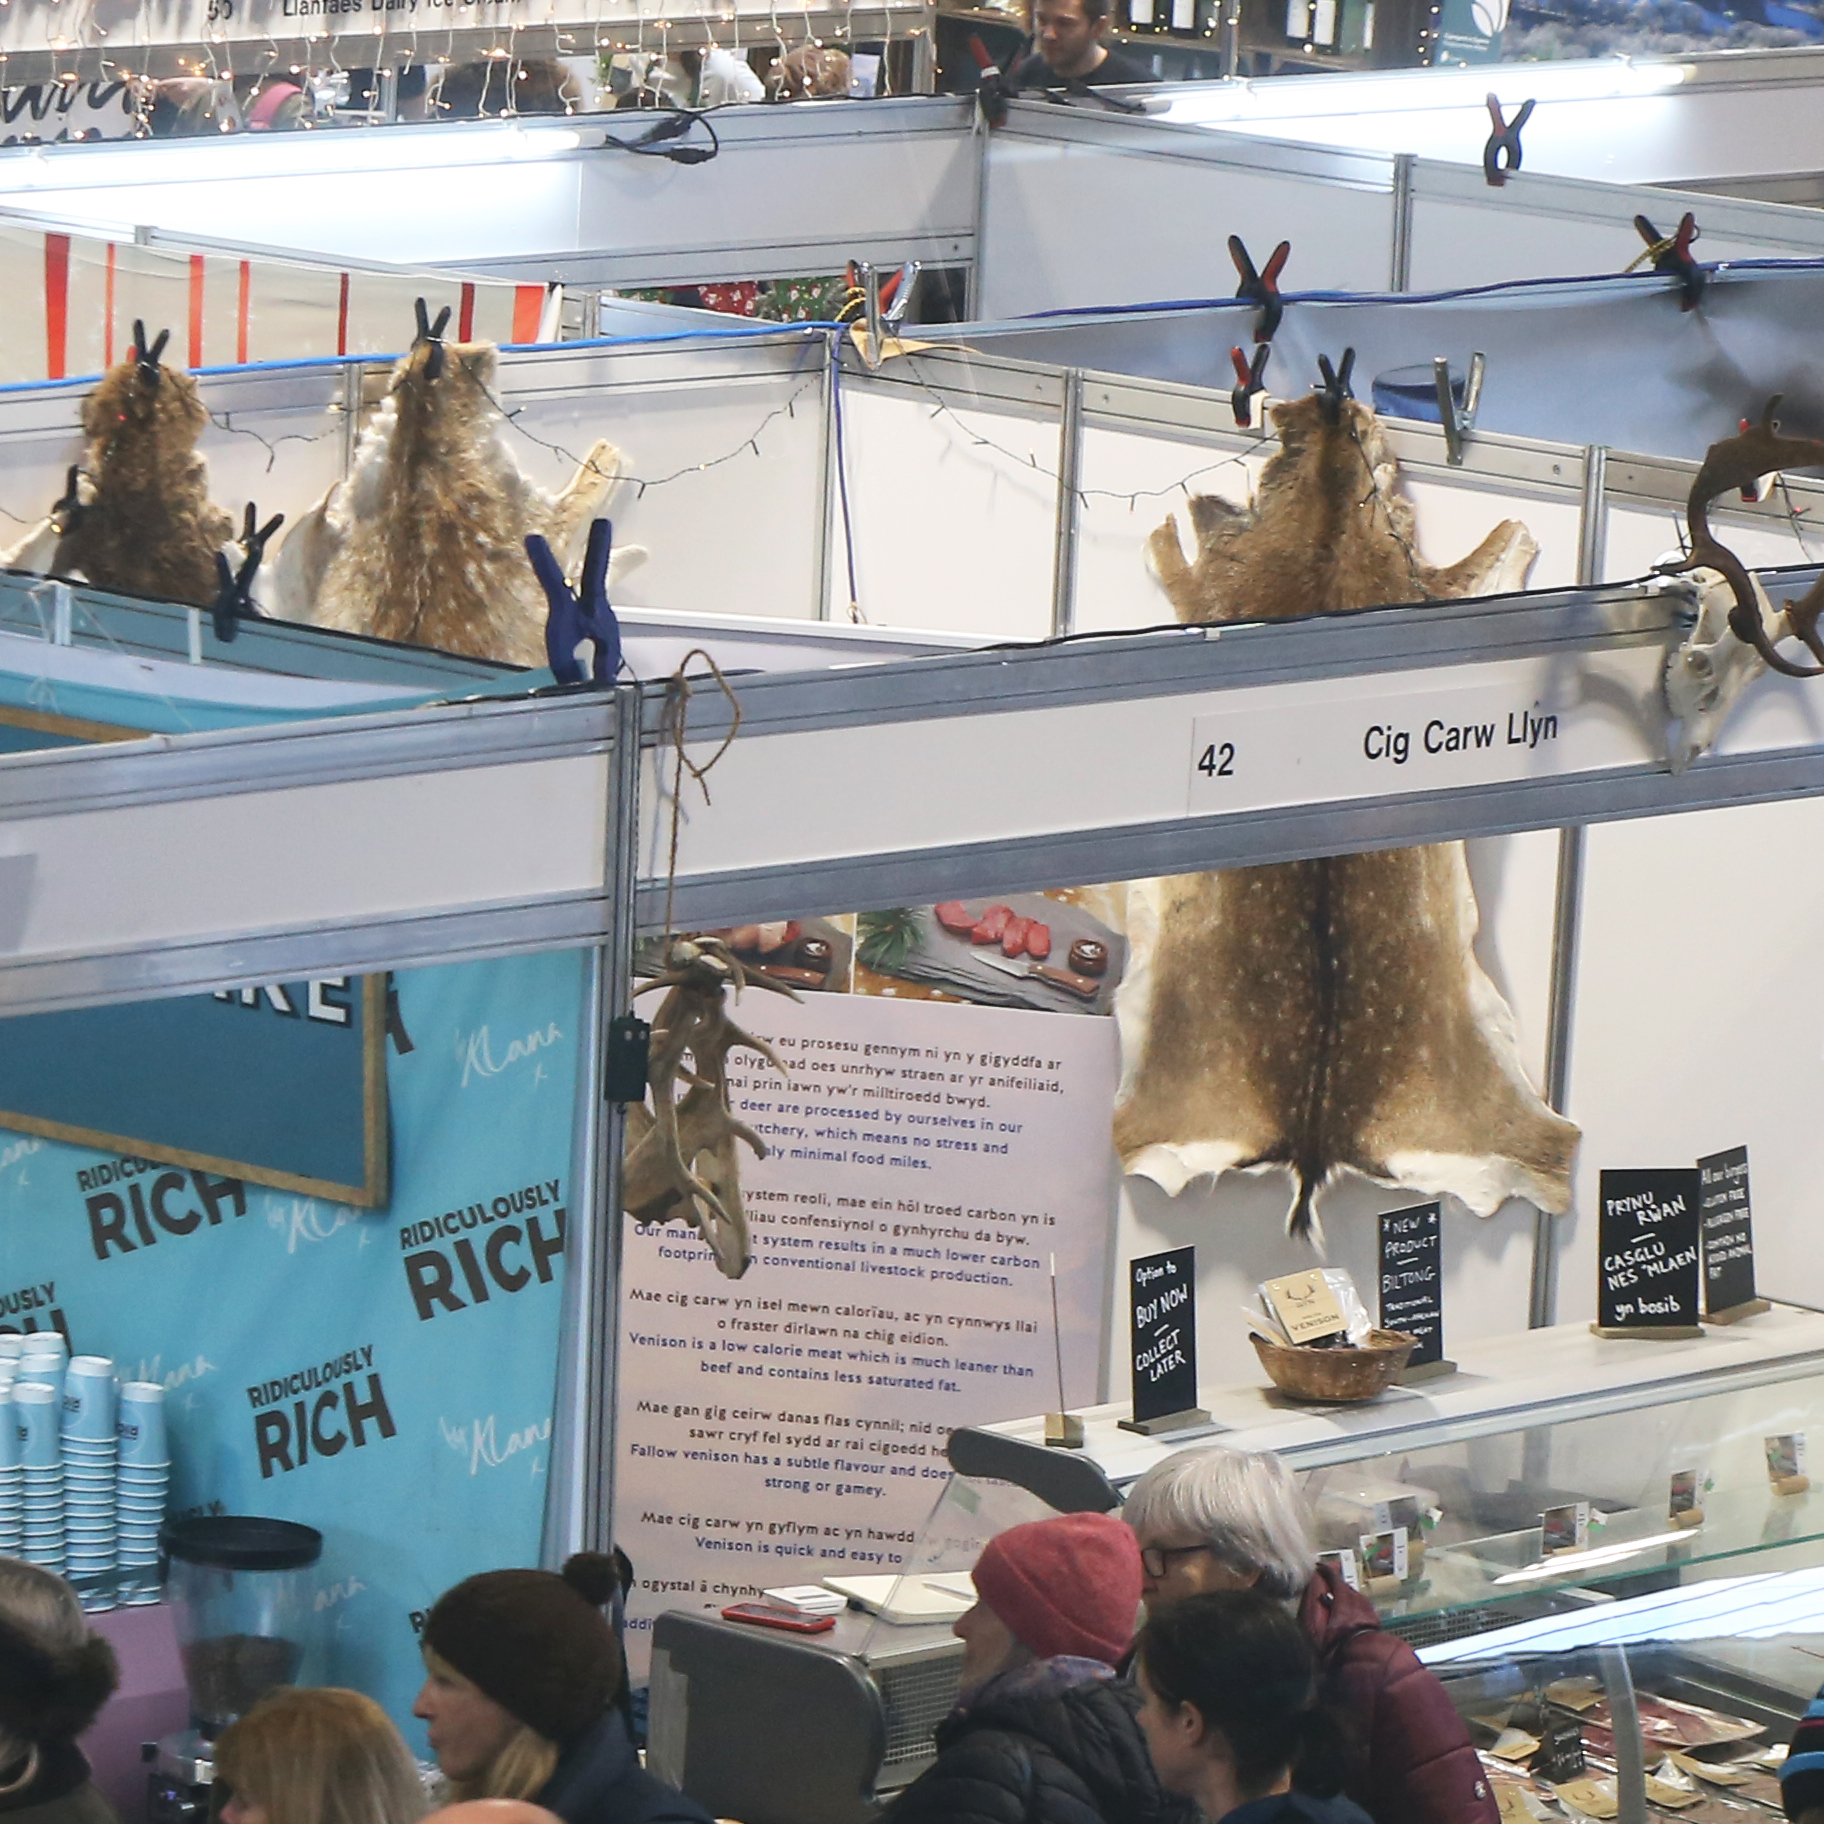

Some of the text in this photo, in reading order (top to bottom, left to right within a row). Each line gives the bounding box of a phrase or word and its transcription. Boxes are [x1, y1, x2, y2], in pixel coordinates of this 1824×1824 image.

[1196, 742, 1236, 778] 42
[1363, 724, 1411, 765] Cig
[1422, 719, 1497, 755] Carw
[778, 1036, 796, 1047] eu
[800, 1038, 859, 1052] prosesu
[863, 1043, 921, 1059] gennym
[924, 1048, 938, 1059] ni
[942, 1050, 962, 1063] yn
[965, 1052, 975, 1065] y
[979, 1051, 1042, 1069] gigyddfa
[1046, 1059, 1062, 1070] ar
[739, 1098, 1024, 1134] deer are processed by ourselves in our
[83, 1168, 249, 1261] RICH
[400, 1178, 561, 1251] RIDICULOUSLY
[1606, 1191, 1654, 1216] PRYNU
[633, 1217, 662, 1237] Our
[762, 1235, 814, 1249] system
[817, 1239, 867, 1253] results
[871, 1240, 886, 1255] in
[888, 1245, 898, 1256] a
[902, 1246, 942, 1260] much
[945, 1247, 986, 1263] lower
[989, 1254, 1040, 1269] carbon
[1384, 1235, 1438, 1259] PRODUCT
[1604, 1241, 1666, 1272] CASGLU
[403, 1207, 569, 1322] RICH
[1135, 1261, 1177, 1289] Option to
[1382, 1265, 1436, 1294] BILTONG
[1607, 1268, 1639, 1291] NES
[628, 1287, 662, 1303] Mae
[665, 1290, 688, 1308] cig
[692, 1294, 730, 1307] carw
[733, 1297, 752, 1311] yn
[756, 1296, 782, 1311] isel
[786, 1301, 830, 1315] mewn
[903, 1311, 920, 1322] ac
[924, 1313, 943, 1326] yn
[946, 1315, 1011, 1333] cynnwys
[1015, 1319, 1038, 1334] llai
[1135, 1283, 1189, 1330] BUY NOW
[1289, 1312, 1341, 1333] VENISON
[1614, 1294, 1681, 1322] yn bosib
[716, 1319, 726, 1330] o
[730, 1316, 779, 1333] fraster
[842, 1328, 860, 1340] na
[864, 1328, 895, 1346] chig
[899, 1330, 949, 1347] eidion.
[628, 1331, 1034, 1378] Venison is a low calorie meat which is much leaner than
[1135, 1327, 1181, 1373] COLLECT
[1149, 1349, 1188, 1383] LATER
[246, 1343, 376, 1409] RIDICULOUSLY
[699, 1359, 962, 1393] beef and contains less saturated fat.
[253, 1372, 397, 1479] RICH
[629, 1442, 678, 1458] Fallow
[681, 1447, 739, 1464] venison
[743, 1451, 769, 1466] has
[772, 1456, 782, 1467] a
[786, 1455, 830, 1470] subtle
[833, 1458, 886, 1474] flavour
[889, 1464, 916, 1477] and
[763, 1477, 887, 1499] strong or gamey.
